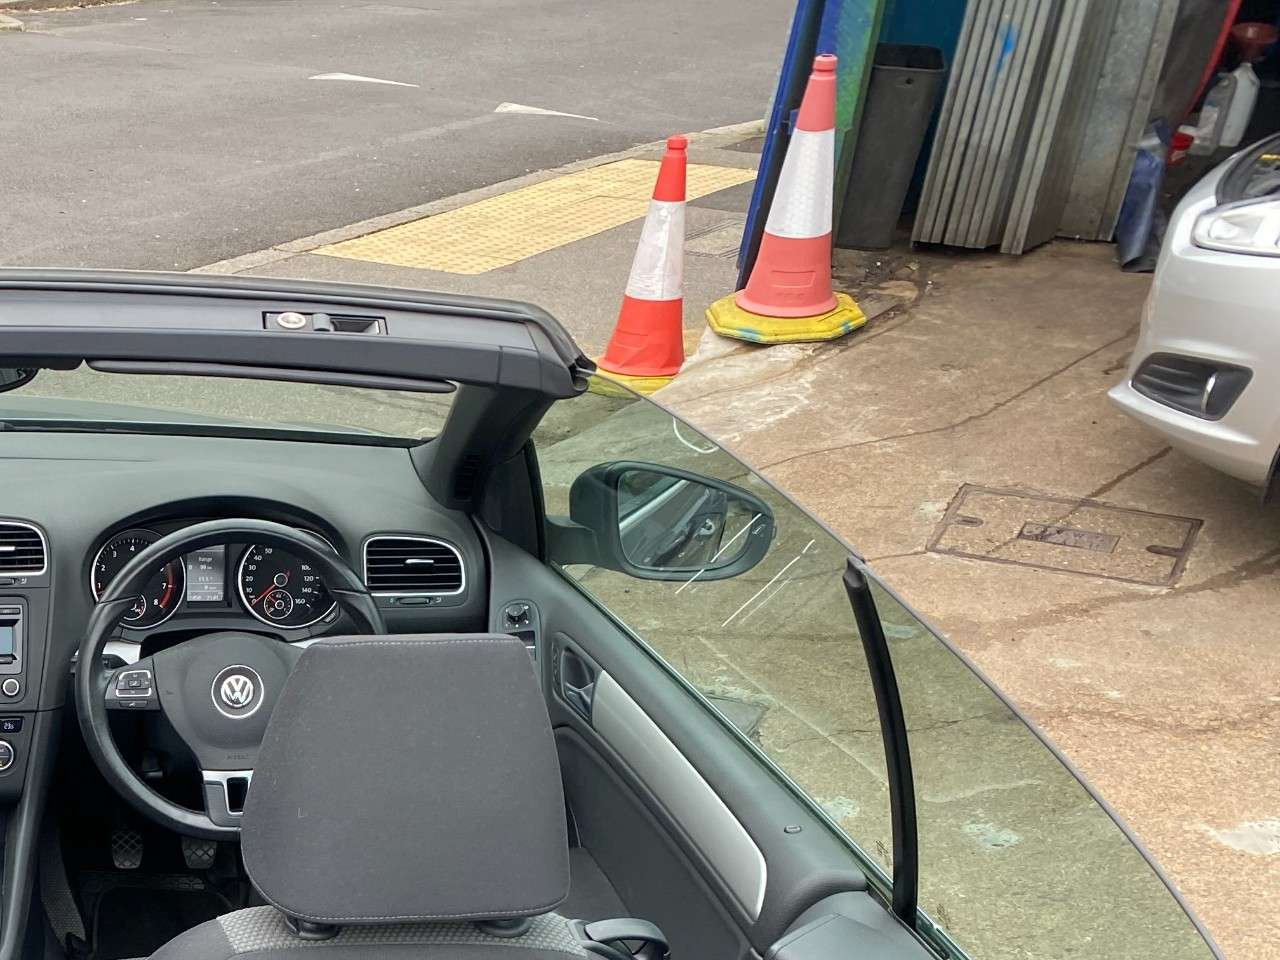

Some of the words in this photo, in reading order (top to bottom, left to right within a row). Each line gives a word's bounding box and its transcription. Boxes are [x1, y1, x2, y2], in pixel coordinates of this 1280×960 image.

[161, 582, 167, 590] 7
[153, 598, 159, 606] 8
[221, 675, 253, 707] VW
